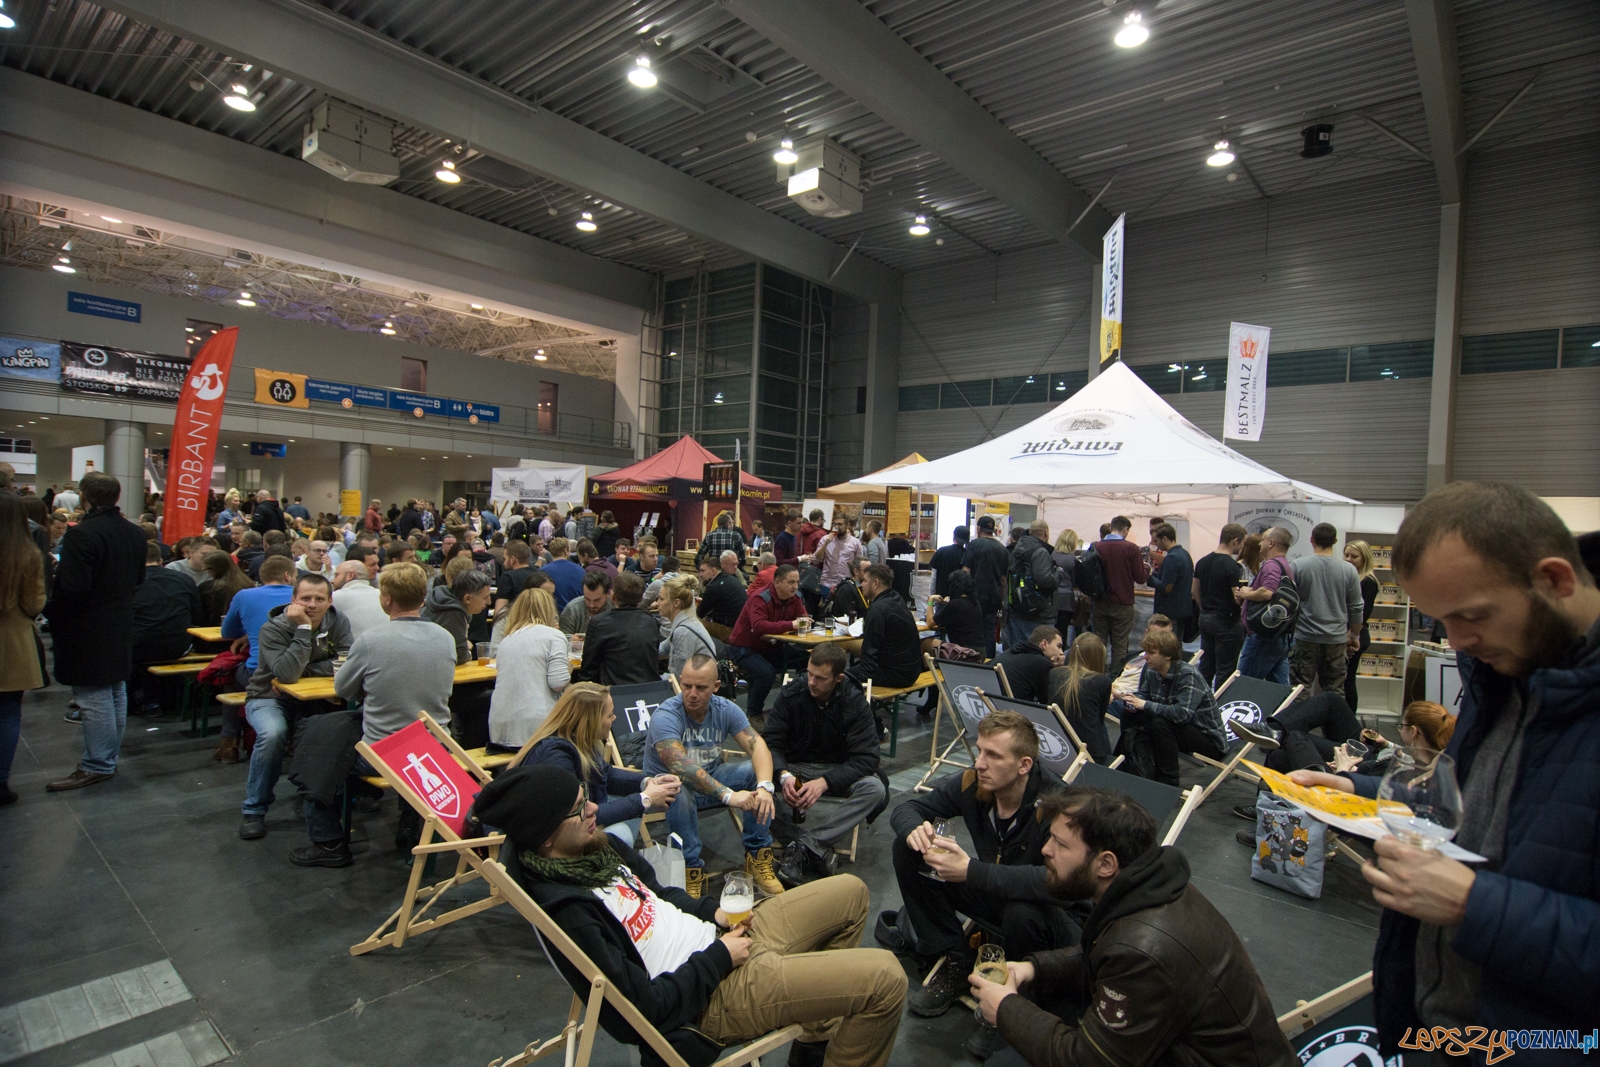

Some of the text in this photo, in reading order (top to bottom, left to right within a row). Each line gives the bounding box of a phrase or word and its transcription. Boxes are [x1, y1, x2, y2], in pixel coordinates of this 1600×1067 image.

[127, 307, 137, 317] B
[136, 359, 191, 371] ALKOMATY
[135, 367, 188, 378] NIE TYLK
[158, 375, 184, 384] POLIC
[66, 379, 109, 392] STOISKO
[137, 388, 180, 398] ZAPRASZA
[433, 400, 441, 408] B
[1237, 363, 1252, 435] BESTMALZ
[1020, 438, 1124, 454] Widawa
[177, 403, 212, 511] BIRBANT
[607, 485, 629, 493] BROWAR
[429, 784, 452, 806] PIWO
